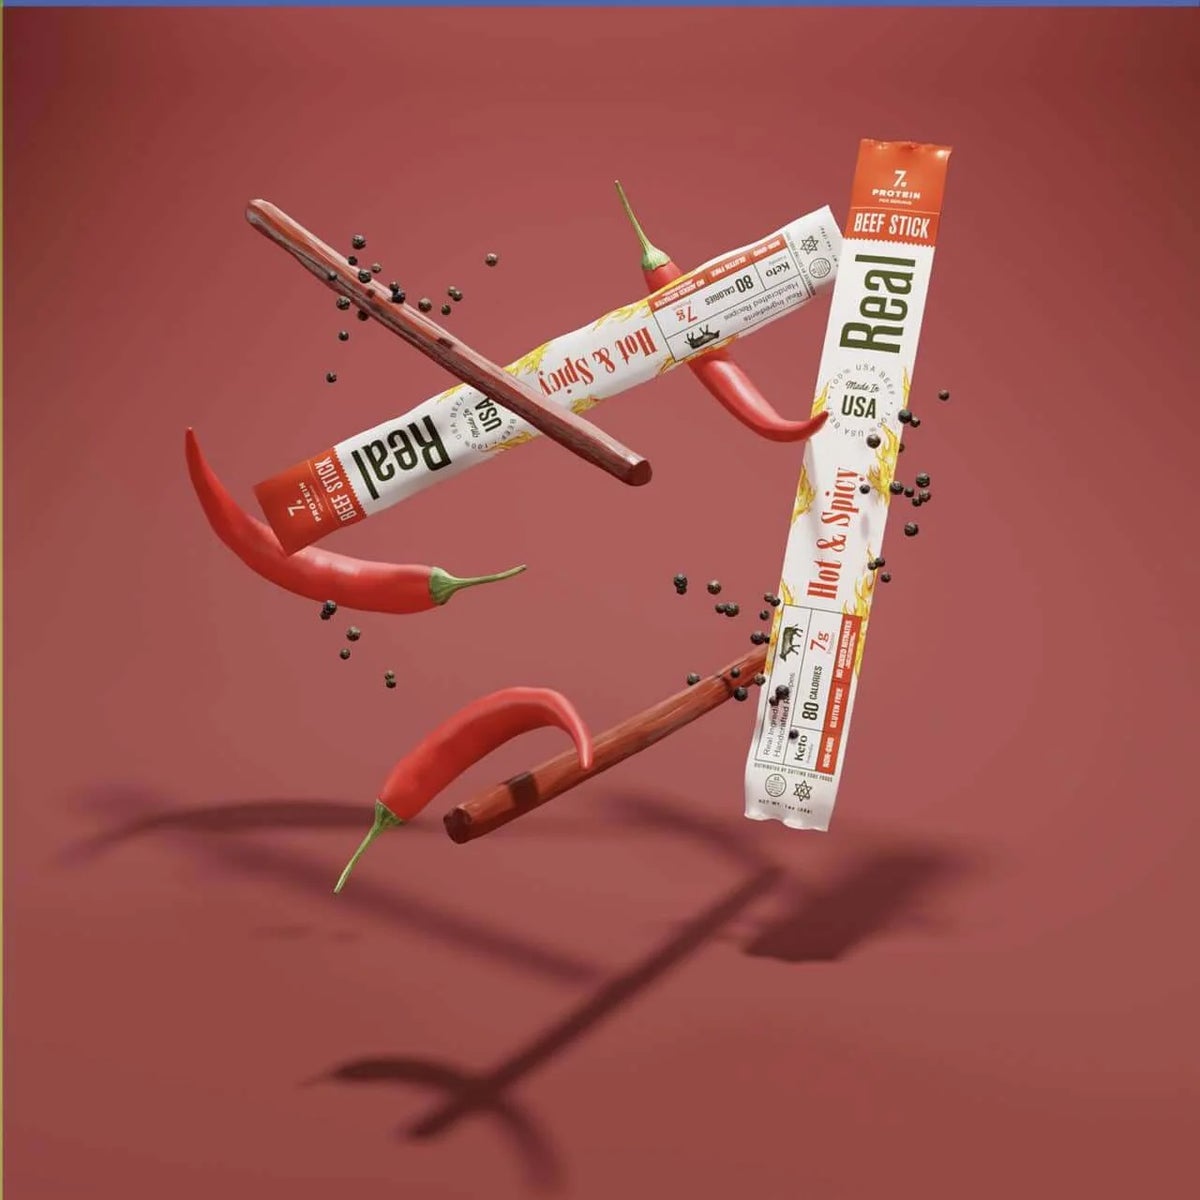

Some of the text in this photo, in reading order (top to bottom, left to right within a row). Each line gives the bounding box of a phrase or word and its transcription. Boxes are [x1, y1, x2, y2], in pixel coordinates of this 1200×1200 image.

[871, 188, 921, 203] PROTEIN
[853, 212, 930, 239] BEEF STICK
[734, 274, 754, 293] 80
[764, 261, 791, 277] Keto
[704, 285, 736, 306] CALORIES
[723, 281, 799, 321] Handcrafted Recipes
[742, 289, 803, 322] Real Ingredients
[838, 253, 916, 354] Real
[675, 305, 698, 323] 7g
[538, 326, 658, 396] Hot & Spicy
[474, 395, 502, 433] USA
[840, 394, 876, 420] USA
[350, 414, 453, 501] Real
[298, 481, 322, 522] PROTEIN
[313, 455, 357, 521] BEEF STICK
[806, 466, 866, 600] Hot & Spicy
[809, 630, 830, 651] 7g
[801, 664, 823, 721] 80 CALORIES
[763, 736, 774, 756] Real
[774, 705, 790, 757] Handcrafted
[793, 734, 808, 761] Keto
